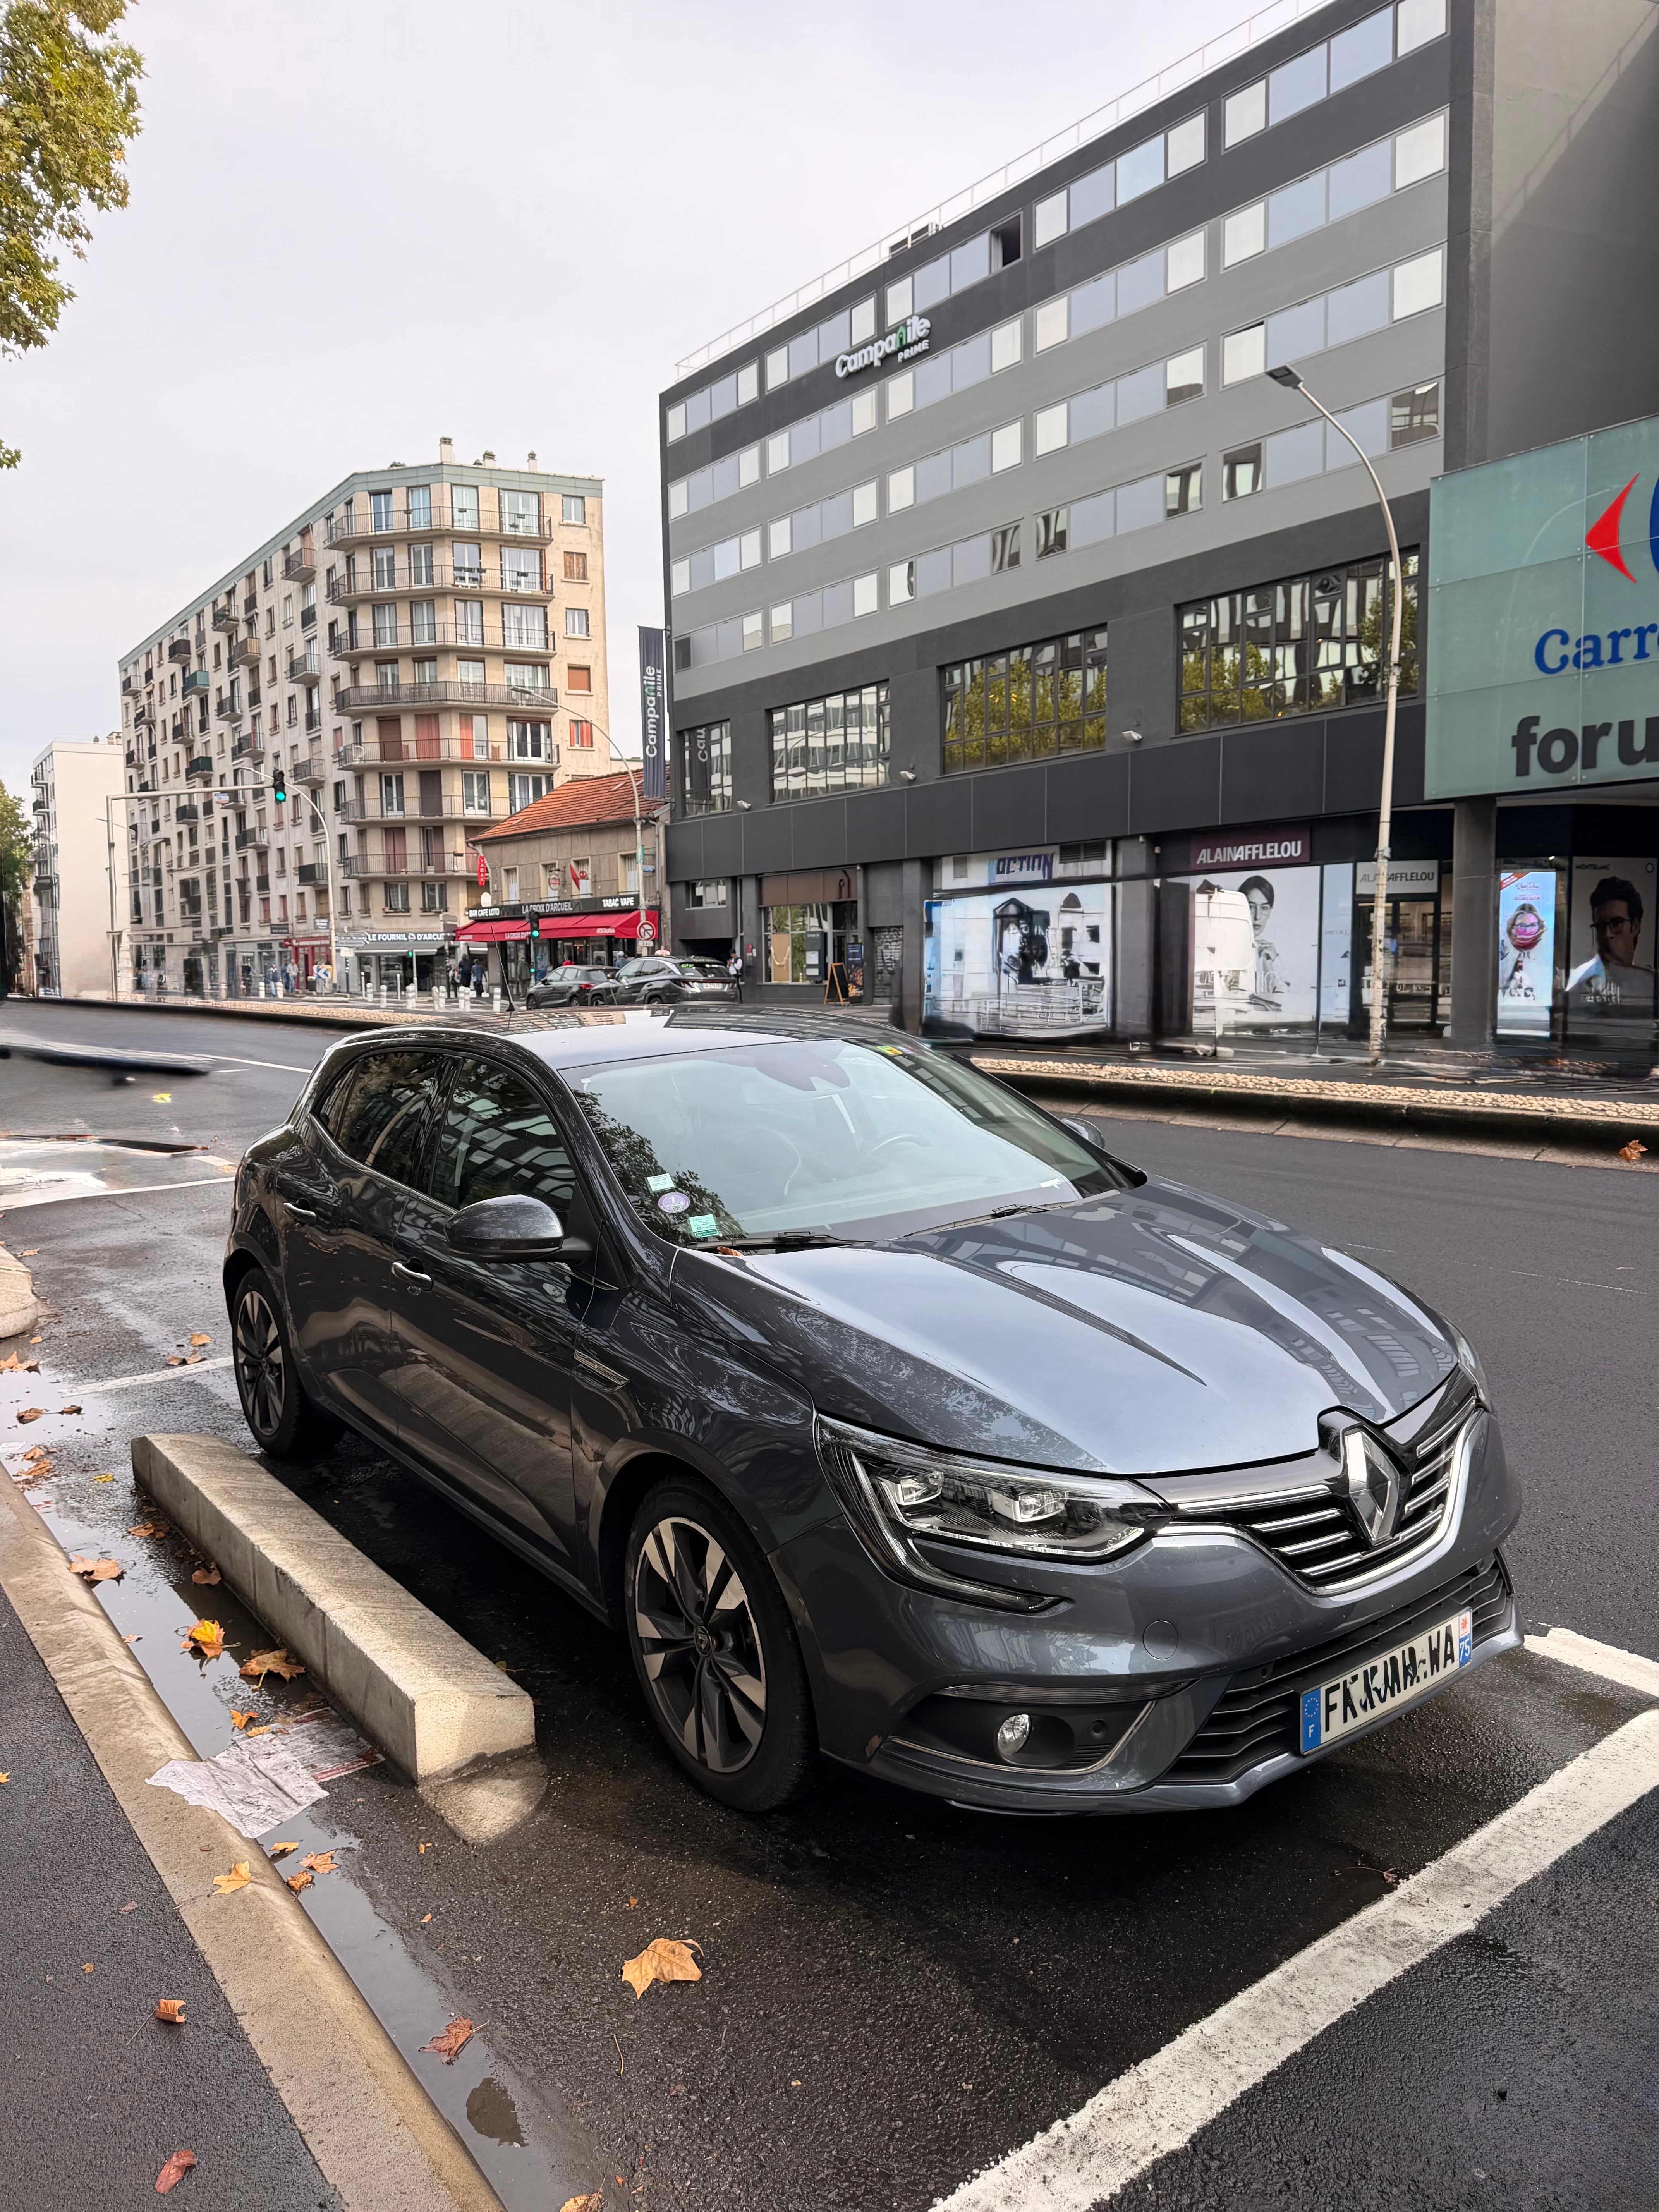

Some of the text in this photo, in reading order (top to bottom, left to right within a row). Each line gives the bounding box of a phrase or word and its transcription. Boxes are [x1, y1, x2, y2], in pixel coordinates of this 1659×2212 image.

[835, 316, 931, 378] Campanile
[898, 339, 929, 362] PRIME
[1534, 623, 1659, 675] Carr
[643, 666, 659, 757] Campanile
[469, 908, 500, 917] BAR CAFE LOTO
[522, 905, 529, 914] LA
[546, 902, 573, 912] D'ARCUEIL
[602, 897, 635, 907] TABAC VAPE
[1459, 1637, 1470, 1661] 75
[1309, 1724, 1314, 1738] F
